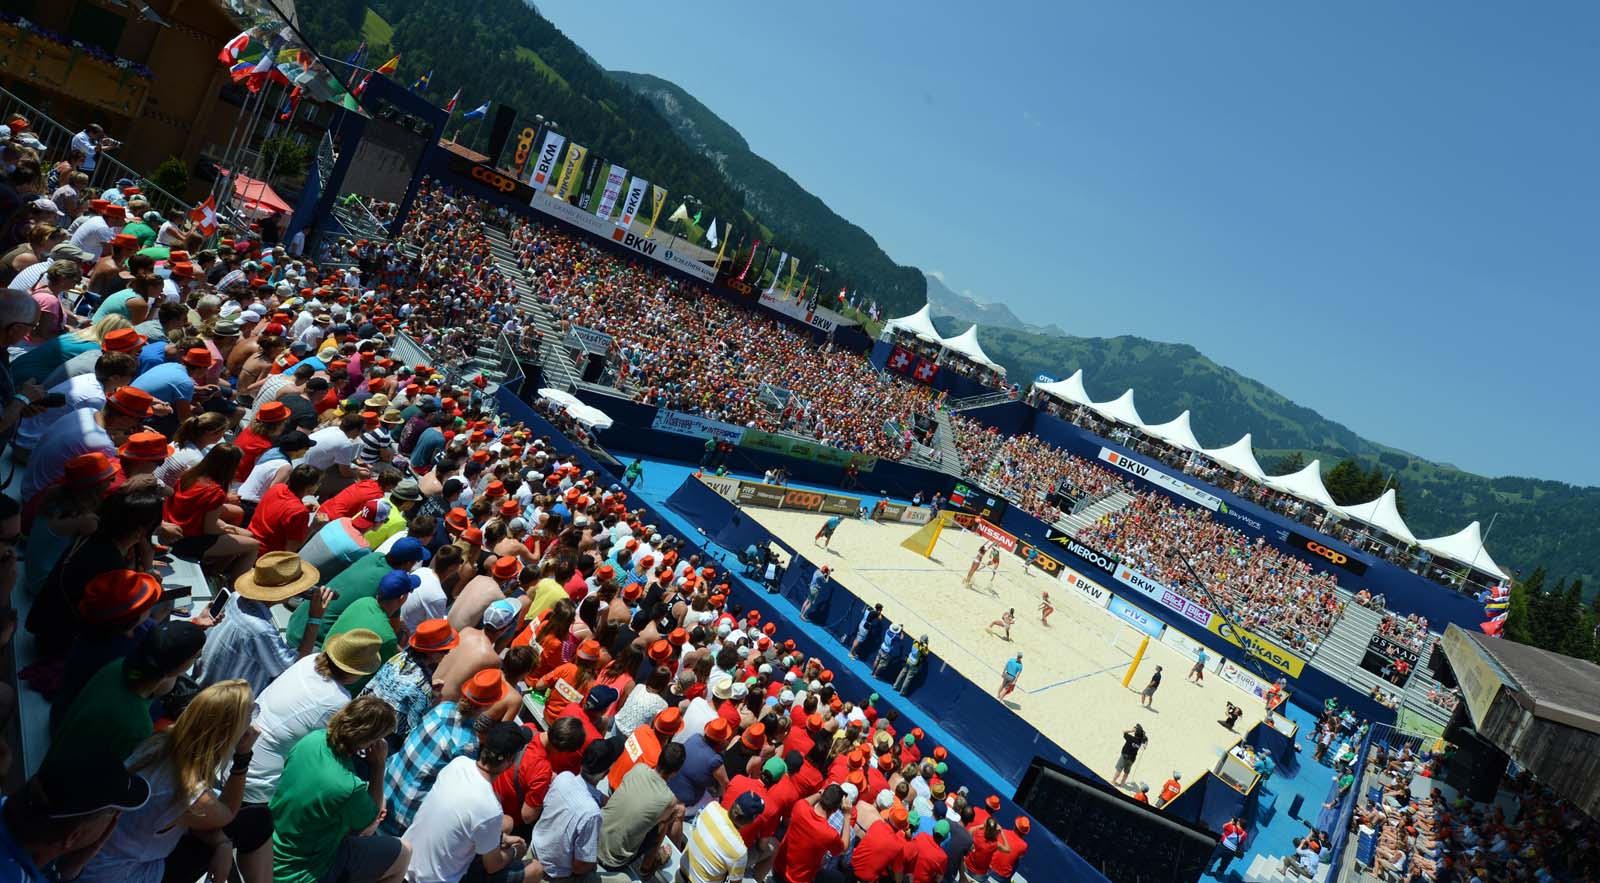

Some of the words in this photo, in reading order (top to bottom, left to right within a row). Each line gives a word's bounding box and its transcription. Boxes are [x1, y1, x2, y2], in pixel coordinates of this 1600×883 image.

[471, 165, 516, 192] coop
[624, 233, 657, 255] BKW
[728, 278, 752, 295] coop
[812, 316, 832, 330] BKW
[1118, 457, 1149, 476] BKW
[785, 491, 822, 510] coop
[976, 523, 1014, 547] NISSAN
[1067, 541, 1115, 572] MEROOJI
[1305, 541, 1347, 565] coop
[1075, 576, 1102, 599] BKW
[1130, 574, 1155, 593] BKW
